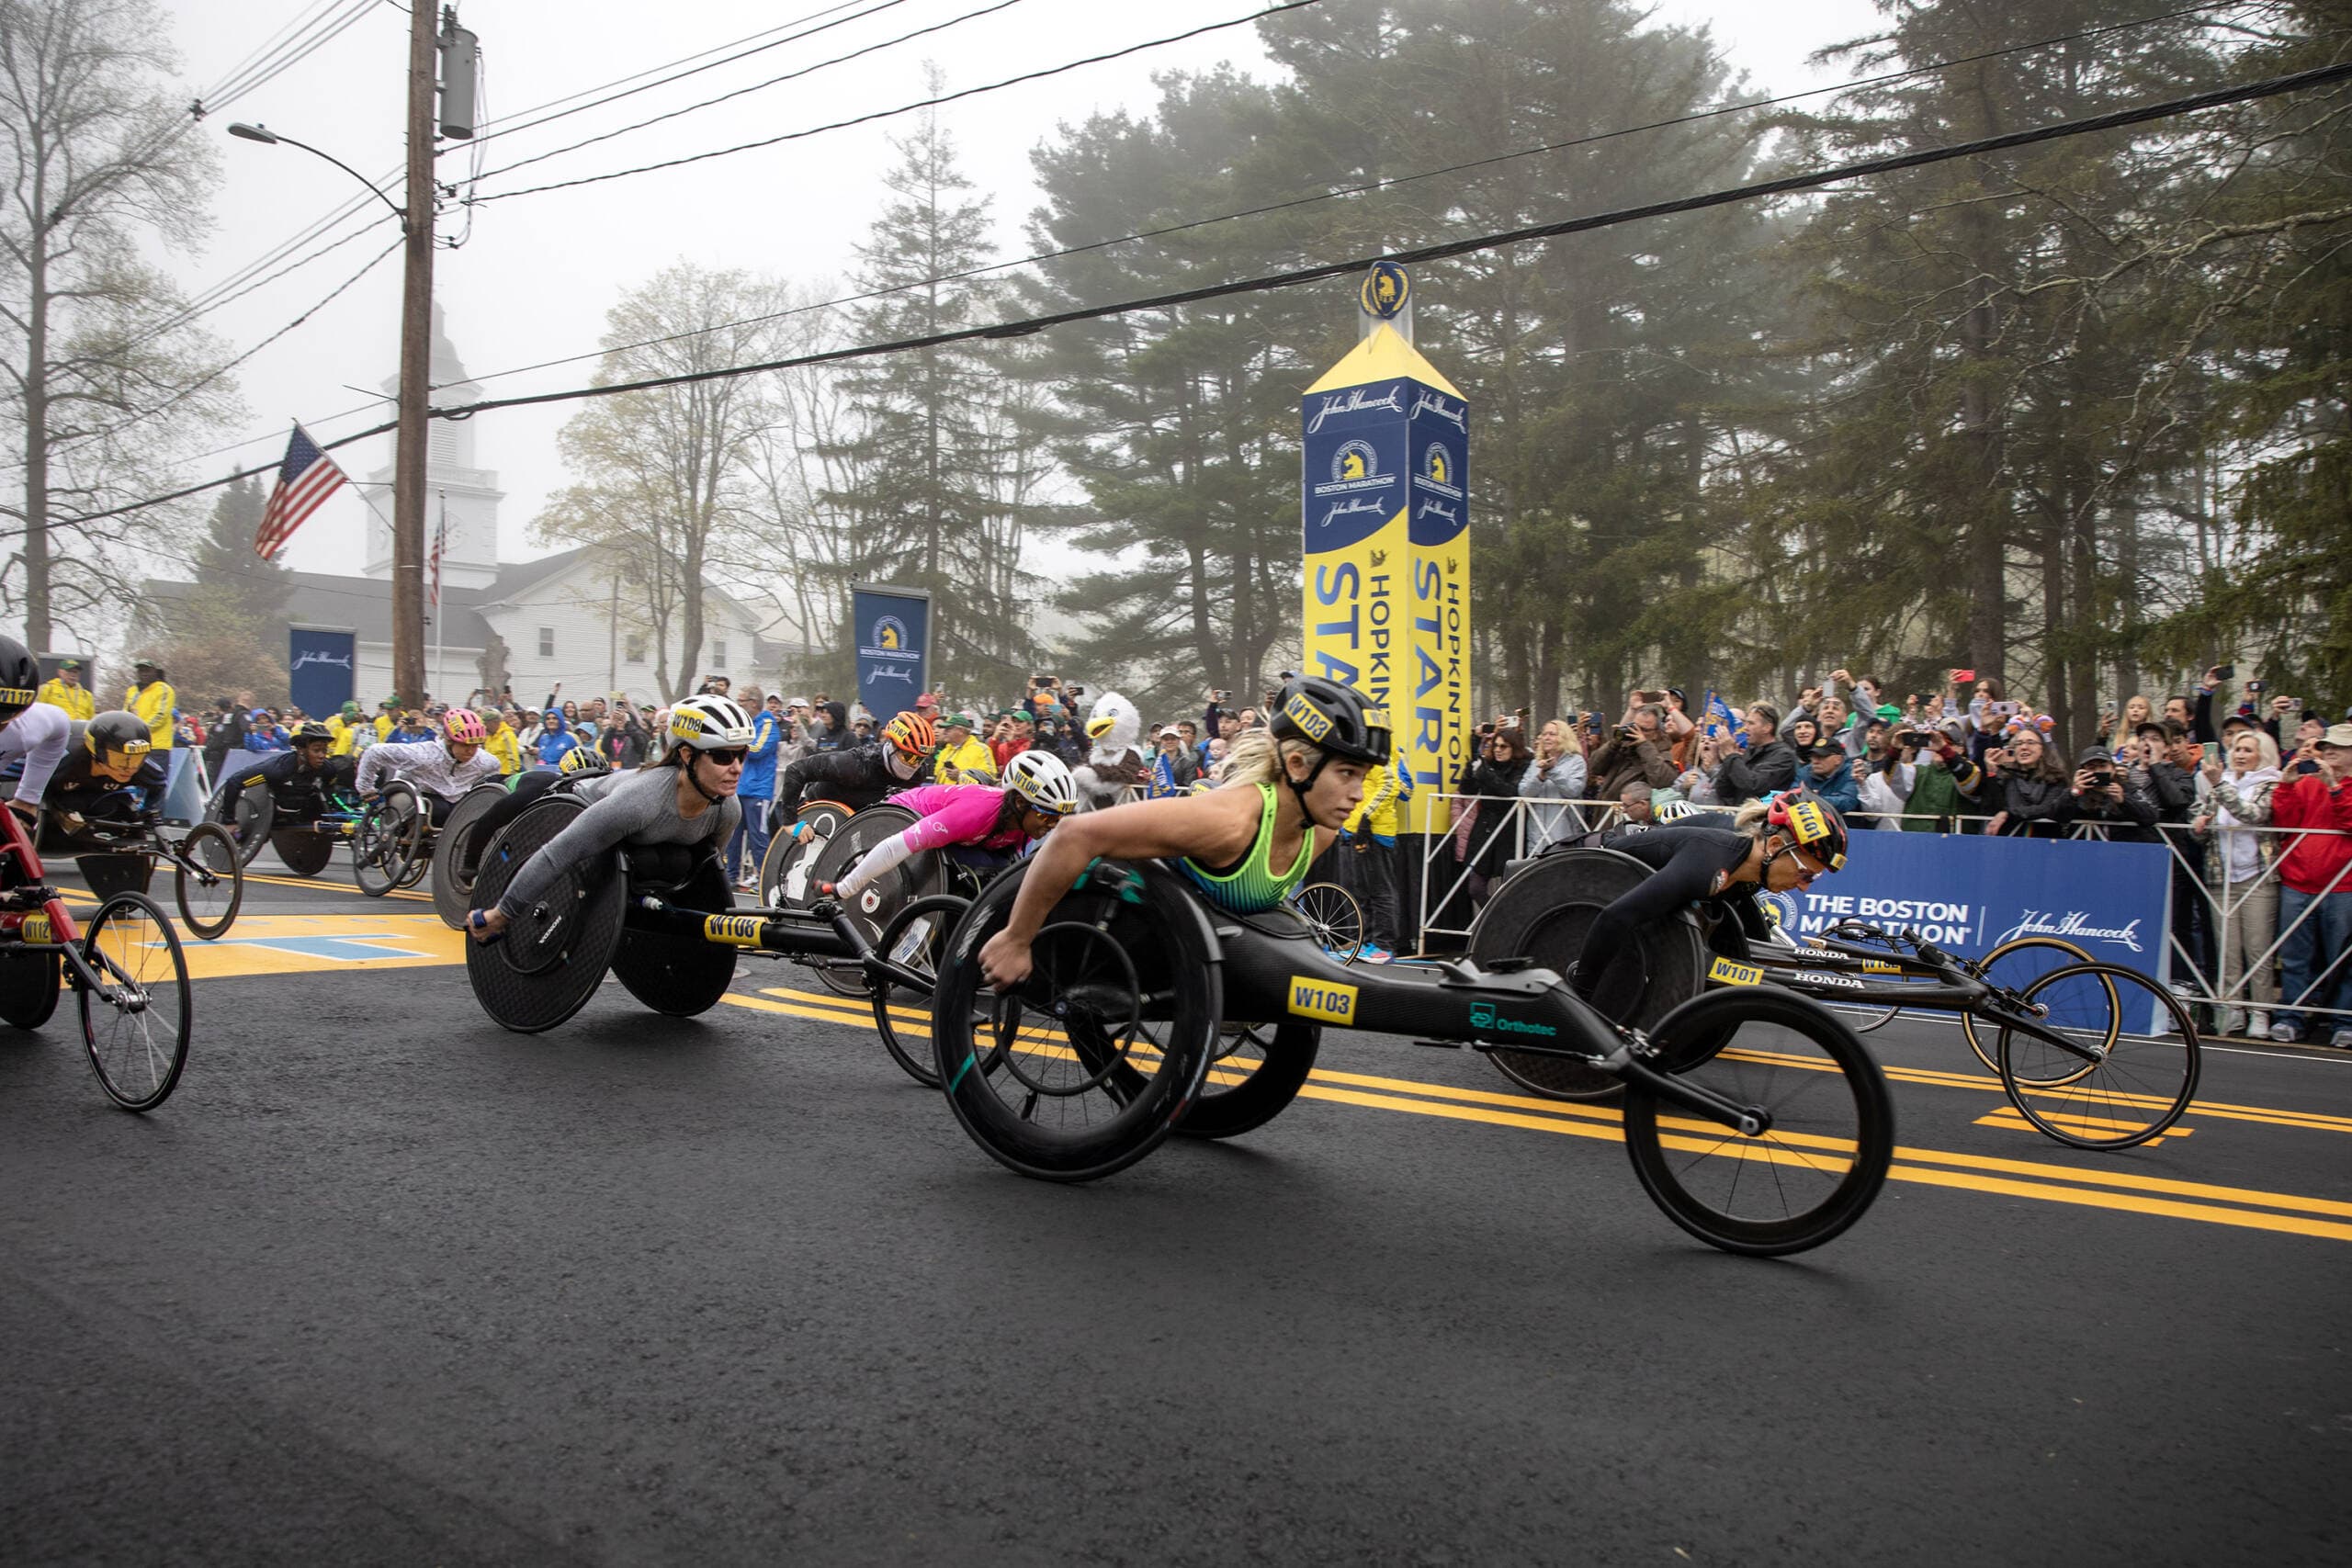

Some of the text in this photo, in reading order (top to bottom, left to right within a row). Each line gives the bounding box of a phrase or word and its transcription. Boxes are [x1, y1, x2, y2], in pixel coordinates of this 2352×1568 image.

[1307, 385, 1404, 434] John Hancock
[1409, 388, 1466, 434] John Hancock
[1315, 483, 1348, 494] BOSTON
[1316, 561, 1360, 689] STA
[1370, 575, 1390, 713] HOPKIN
[1414, 557, 1443, 802] START
[1447, 582, 1462, 784] HOPKINTON
[673, 713, 702, 733] W108
[1288, 697, 1328, 738] W103
[1014, 772, 1039, 795] W106
[1796, 803, 1821, 839] W101
[1805, 894, 1854, 914] THE
[1860, 897, 1969, 923] BOSTON
[25, 921, 50, 939] W112
[710, 915, 756, 939] W108
[1995, 909, 2143, 953] John Hancock
[1793, 948, 1850, 961] HONDA
[1715, 962, 1757, 983] W101
[1793, 972, 1865, 989] HONDA
[1295, 987, 1350, 1015] W103
